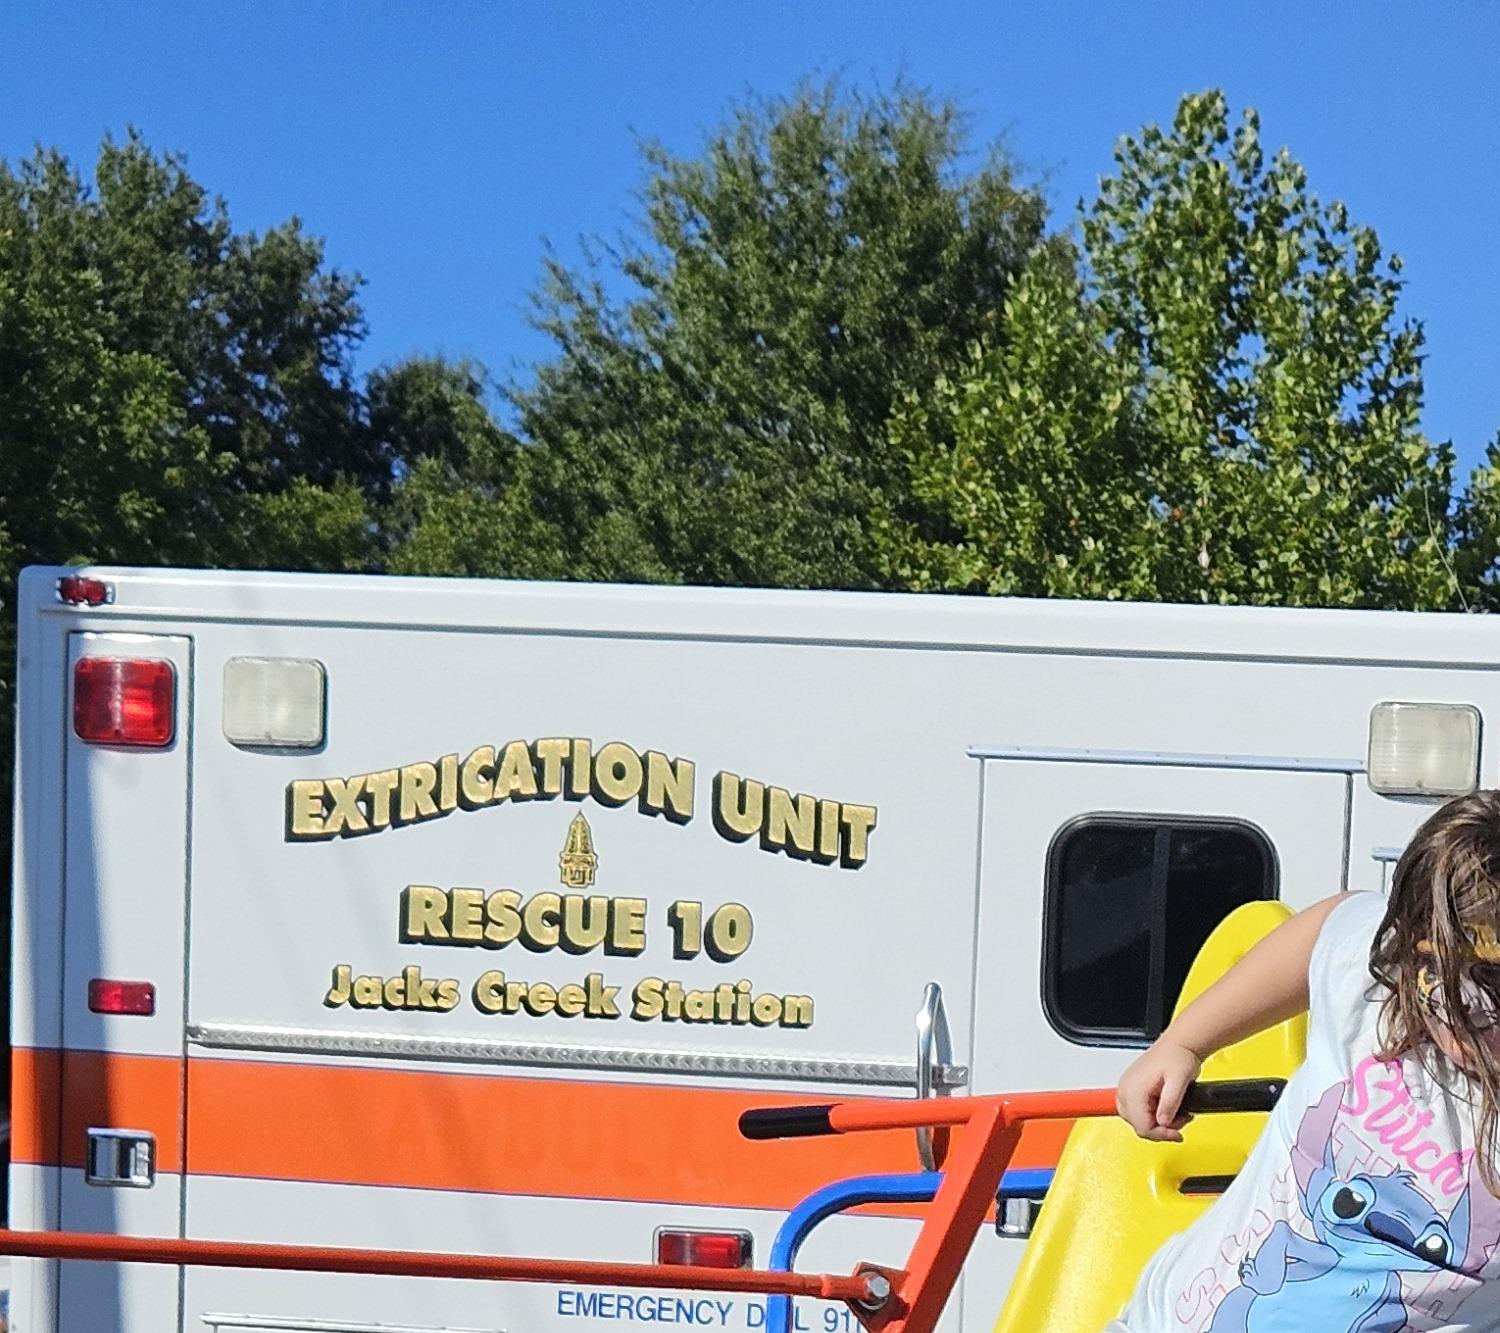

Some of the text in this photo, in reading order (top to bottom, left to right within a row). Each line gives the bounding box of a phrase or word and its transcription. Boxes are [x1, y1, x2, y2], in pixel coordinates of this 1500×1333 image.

[285, 738, 877, 870] EXTRICATION UNIT
[399, 885, 754, 963] RESCUE 10
[323, 964, 814, 1029] Jacks Creek Station
[1340, 1054, 1476, 1196] Stitch
[557, 1290, 734, 1326] EMERGENCY
[746, 1302, 810, 1331] DL
